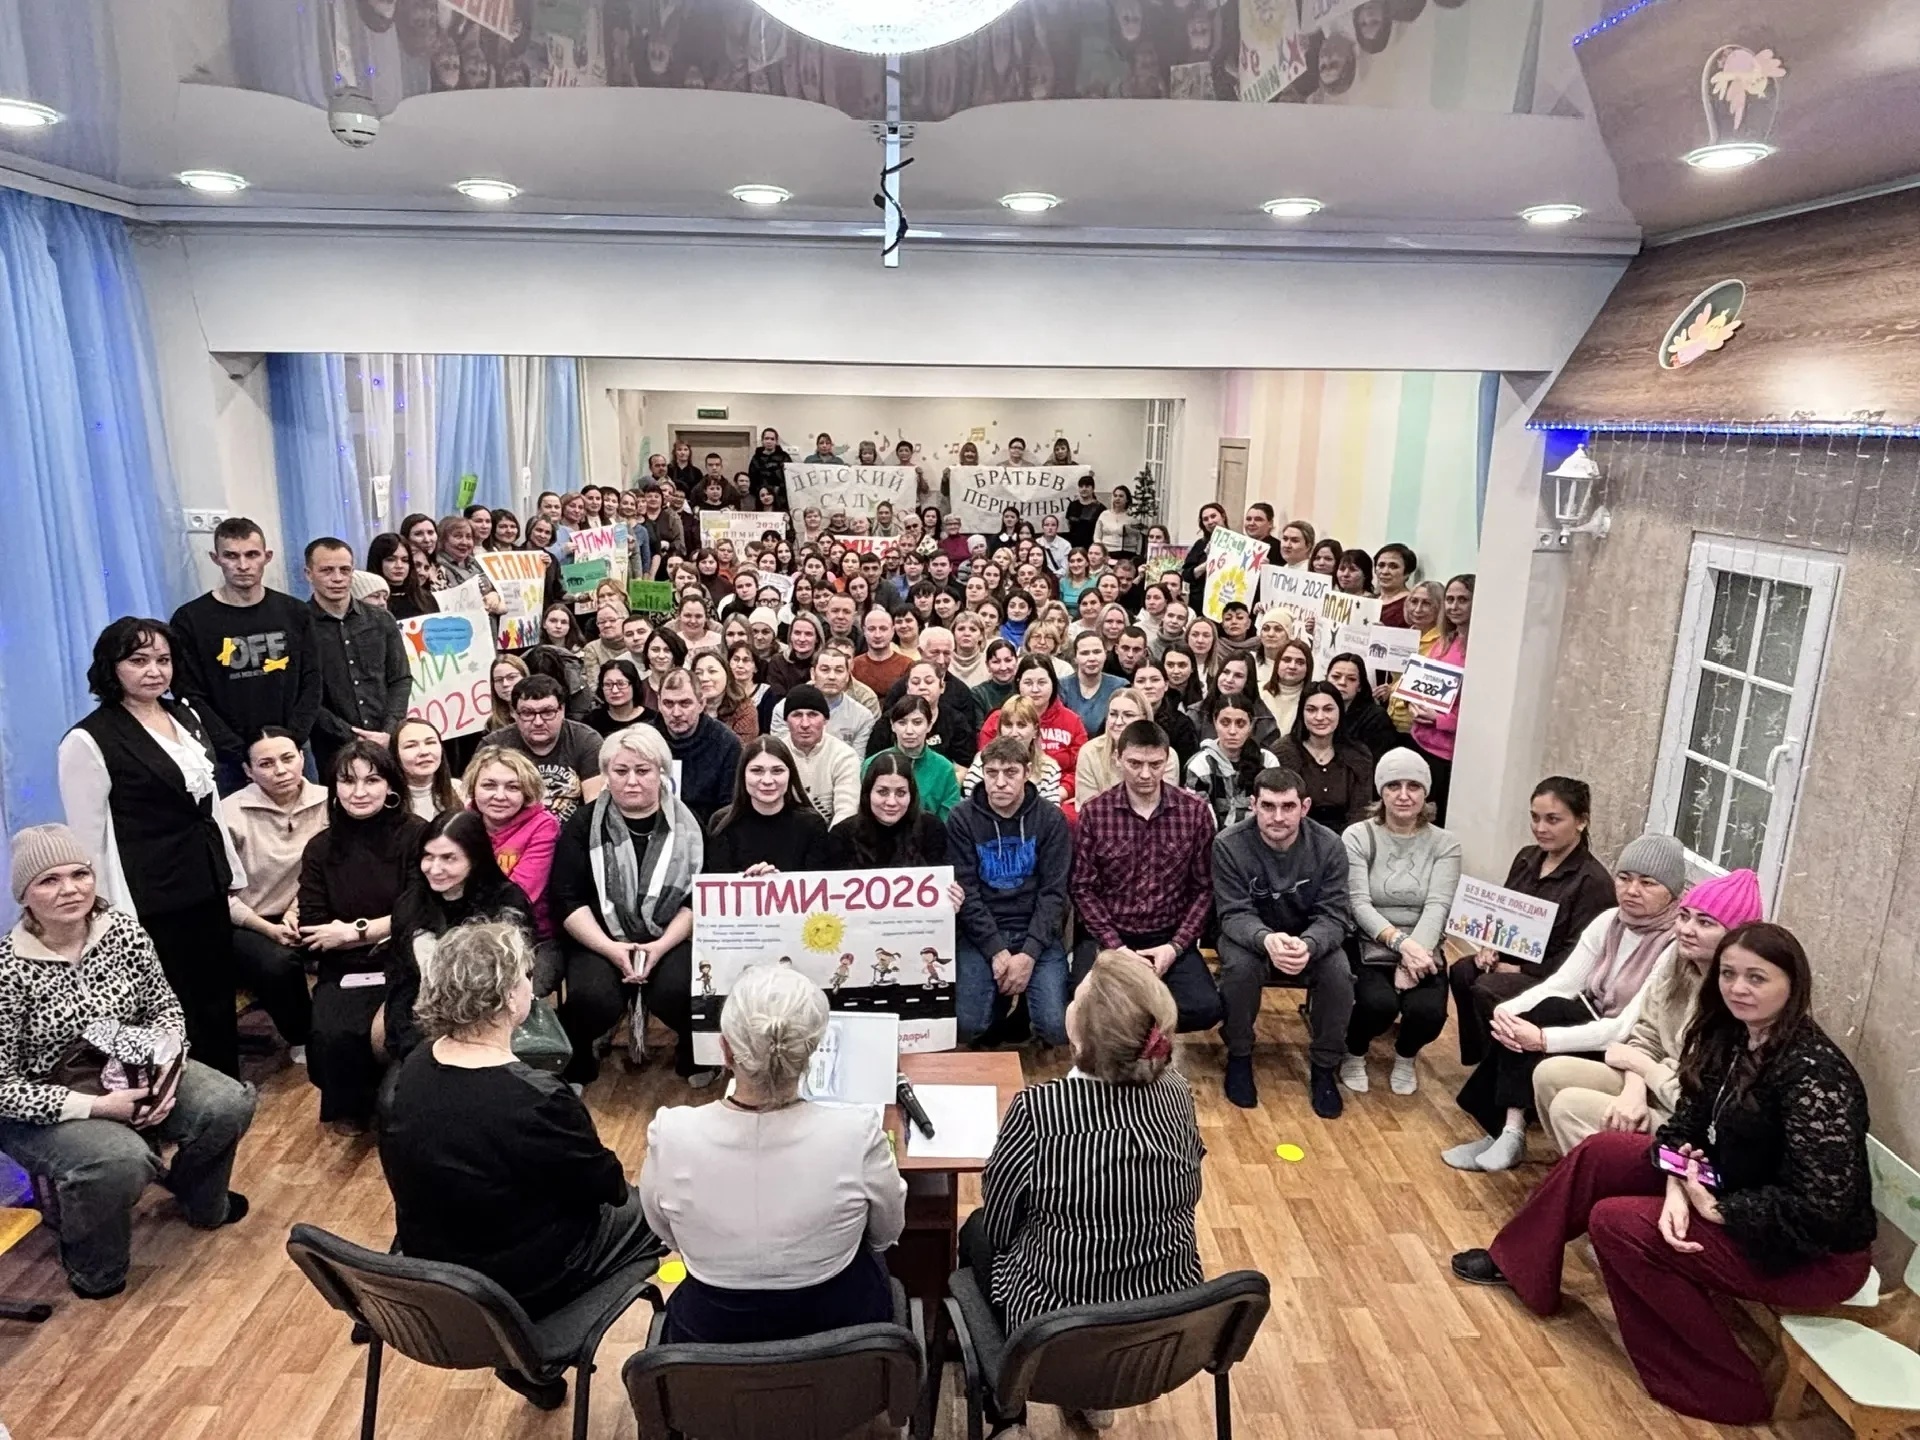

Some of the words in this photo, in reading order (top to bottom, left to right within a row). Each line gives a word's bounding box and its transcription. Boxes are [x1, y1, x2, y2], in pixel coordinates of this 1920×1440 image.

[792, 468, 904, 492] ДЕТСКИЙ
[974, 469, 1065, 491] БРАТЬЕВ
[820, 493, 865, 508] САД
[573, 527, 614, 555] ППМИ
[1410, 679, 1440, 697] 2026
[695, 873, 940, 917] ППМИ-2026
